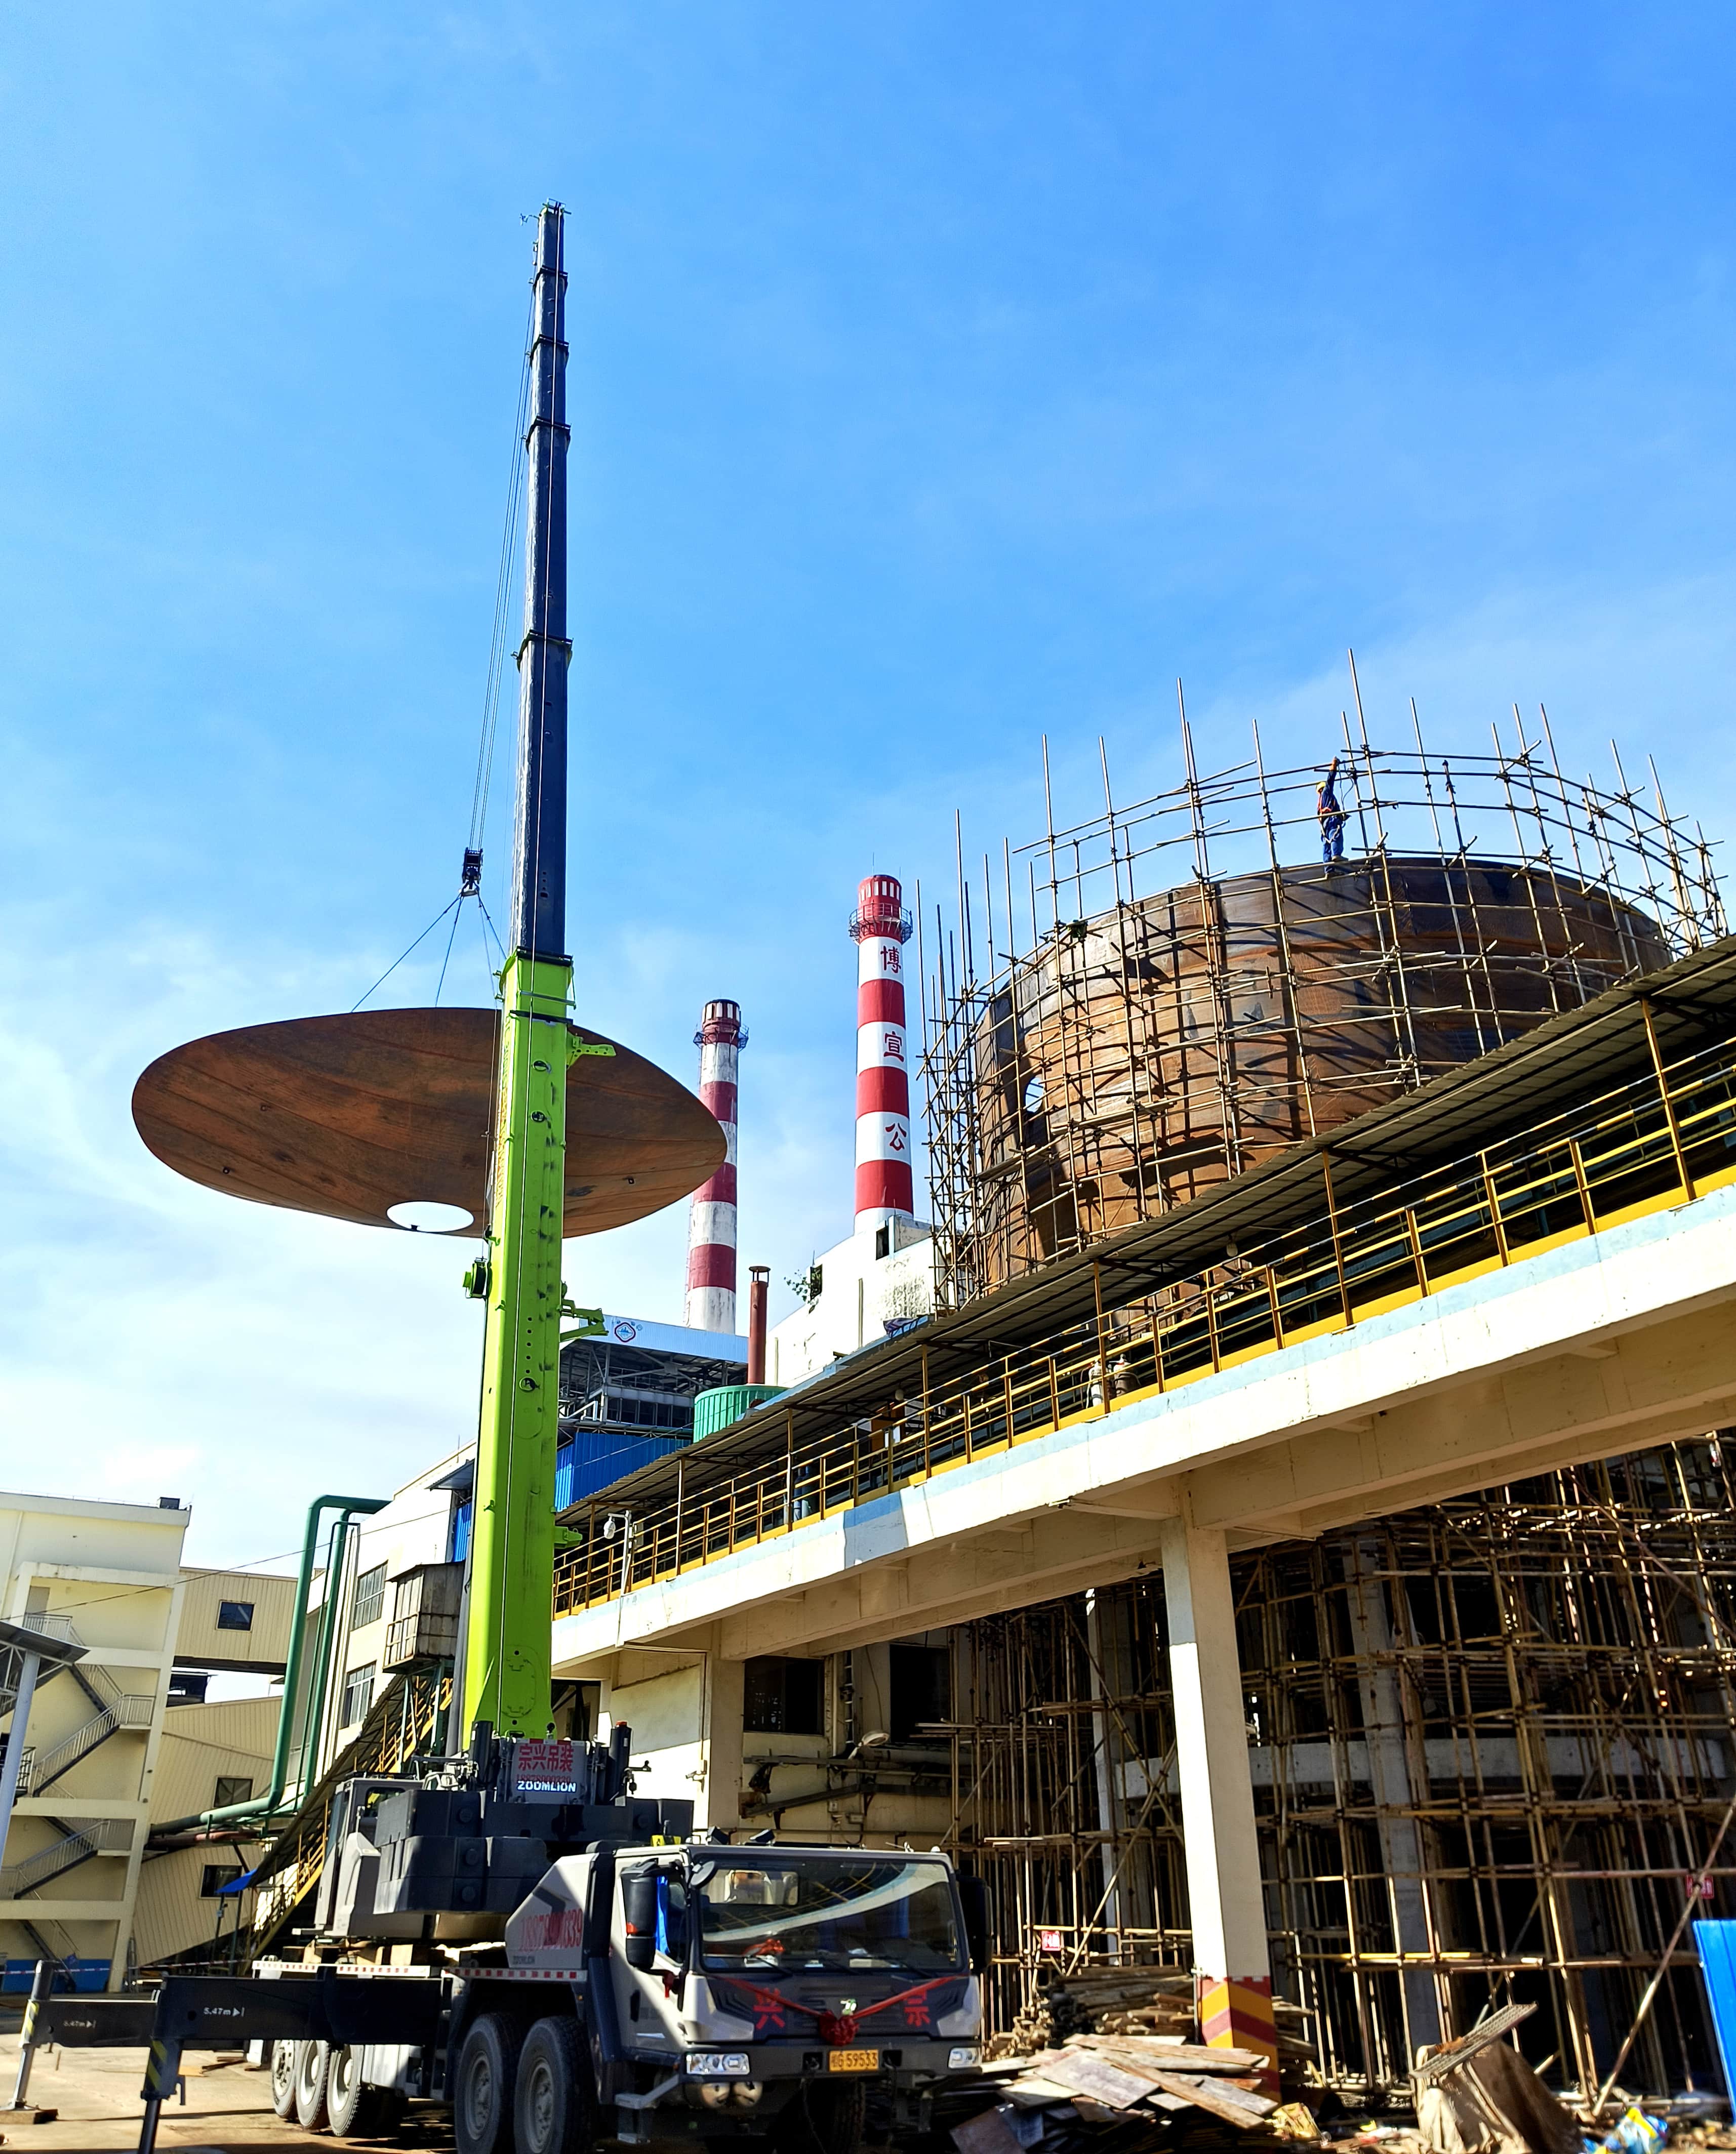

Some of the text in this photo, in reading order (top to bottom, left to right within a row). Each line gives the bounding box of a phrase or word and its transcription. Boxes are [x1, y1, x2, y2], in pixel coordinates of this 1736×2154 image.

[518, 1744, 574, 1772] 宗兴吊装
[517, 1780, 576, 1793] ZOOMLION
